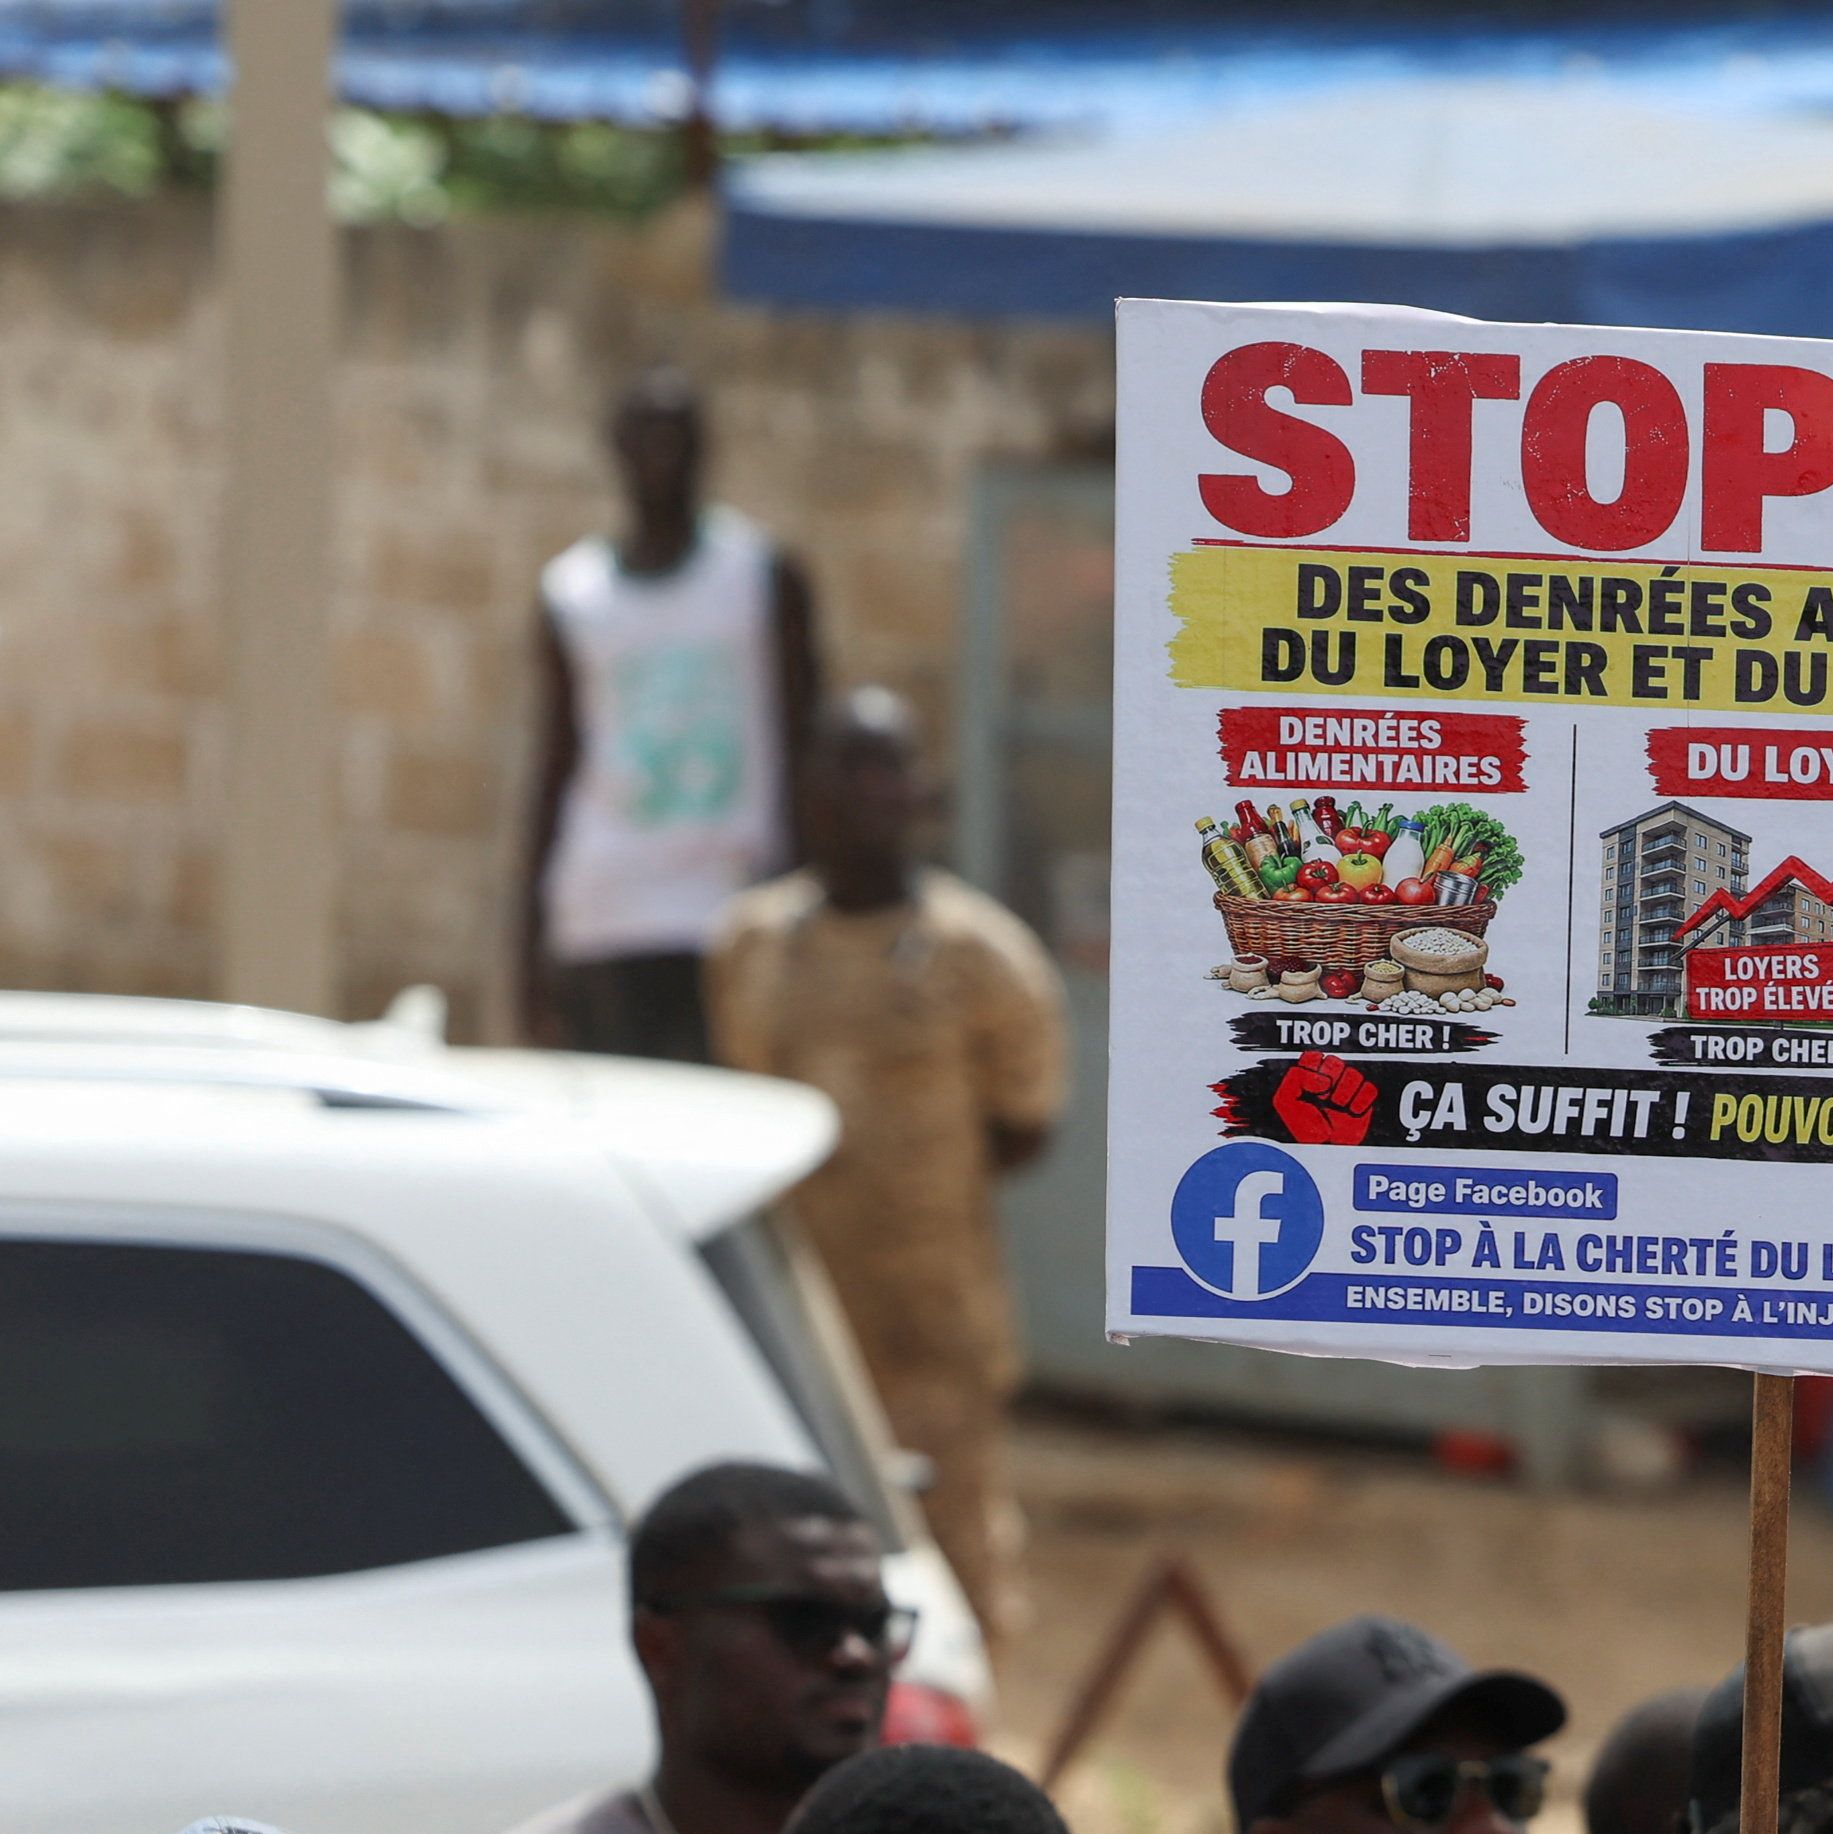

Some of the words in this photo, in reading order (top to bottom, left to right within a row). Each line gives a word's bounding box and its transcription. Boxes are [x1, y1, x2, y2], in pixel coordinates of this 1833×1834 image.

[1296, 563, 1431, 625] DES
[1455, 566, 1772, 640] DENRÉES
[1261, 627, 1356, 682] DU
[1384, 632, 1609, 694] LOYER
[1632, 644, 1714, 699] ET
[1734, 649, 1828, 706] DU
[1279, 712, 1442, 749] DENRÉES
[1238, 751, 1502, 786] ALIMENTAIRES
[1688, 743, 1750, 780] DU
[1724, 953, 1820, 981] LOYERS
[1695, 986, 1757, 1011] TROP
[1276, 1019, 1354, 1047] TROP
[1358, 1021, 1434, 1049] CHER
[1690, 1035, 1763, 1061] TROP
[1399, 1080, 1467, 1141] ÇA
[1483, 1083, 1660, 1138] SUFFIT
[1367, 1174, 1446, 1204] Page
[1455, 1177, 1603, 1209] Facebook
[1350, 1224, 1461, 1267] STOP
[1471, 1220, 1501, 1269] À
[1513, 1231, 1565, 1272] LA
[1576, 1230, 1738, 1278] CHERTÉ
[1751, 1240, 1809, 1280] DU
[1346, 1285, 1514, 1318] ENSEMBLE,
[1523, 1292, 1636, 1319] DISONS
[1645, 1296, 1723, 1322] STOP
[1731, 1294, 1753, 1323] À
